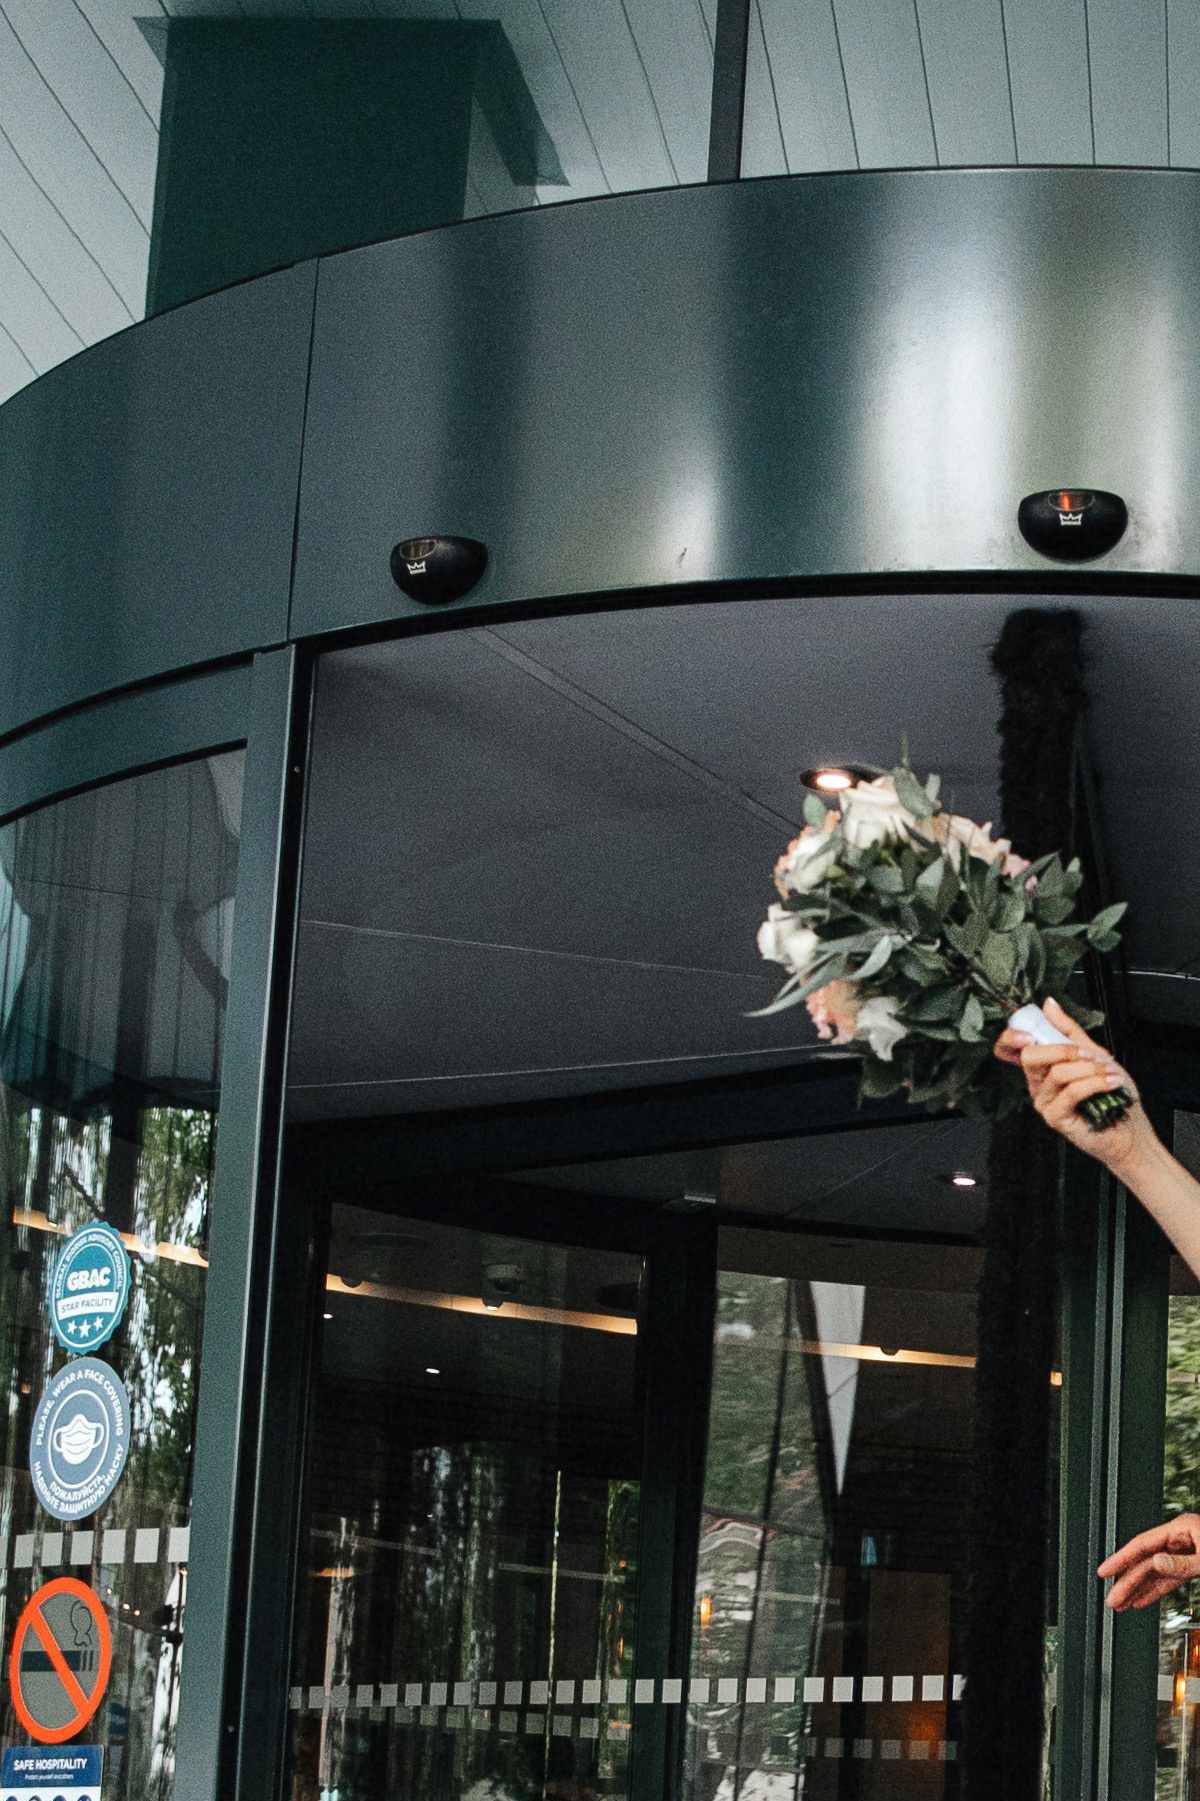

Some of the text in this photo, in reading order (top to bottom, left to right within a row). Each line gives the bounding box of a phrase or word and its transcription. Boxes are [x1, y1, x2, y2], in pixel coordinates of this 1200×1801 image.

[67, 1266, 111, 1291] GBAC
[61, 1298, 114, 1314] STAR FACILITY
[52, 1372, 76, 1398] WEAR
[76, 1369, 84, 1380] A
[84, 1368, 106, 1385] FACE
[103, 1380, 124, 1437] COVERING
[103, 1443, 124, 1487] МАСКУ
[13, 1757, 88, 1771] SAFE HOSPITALITY
